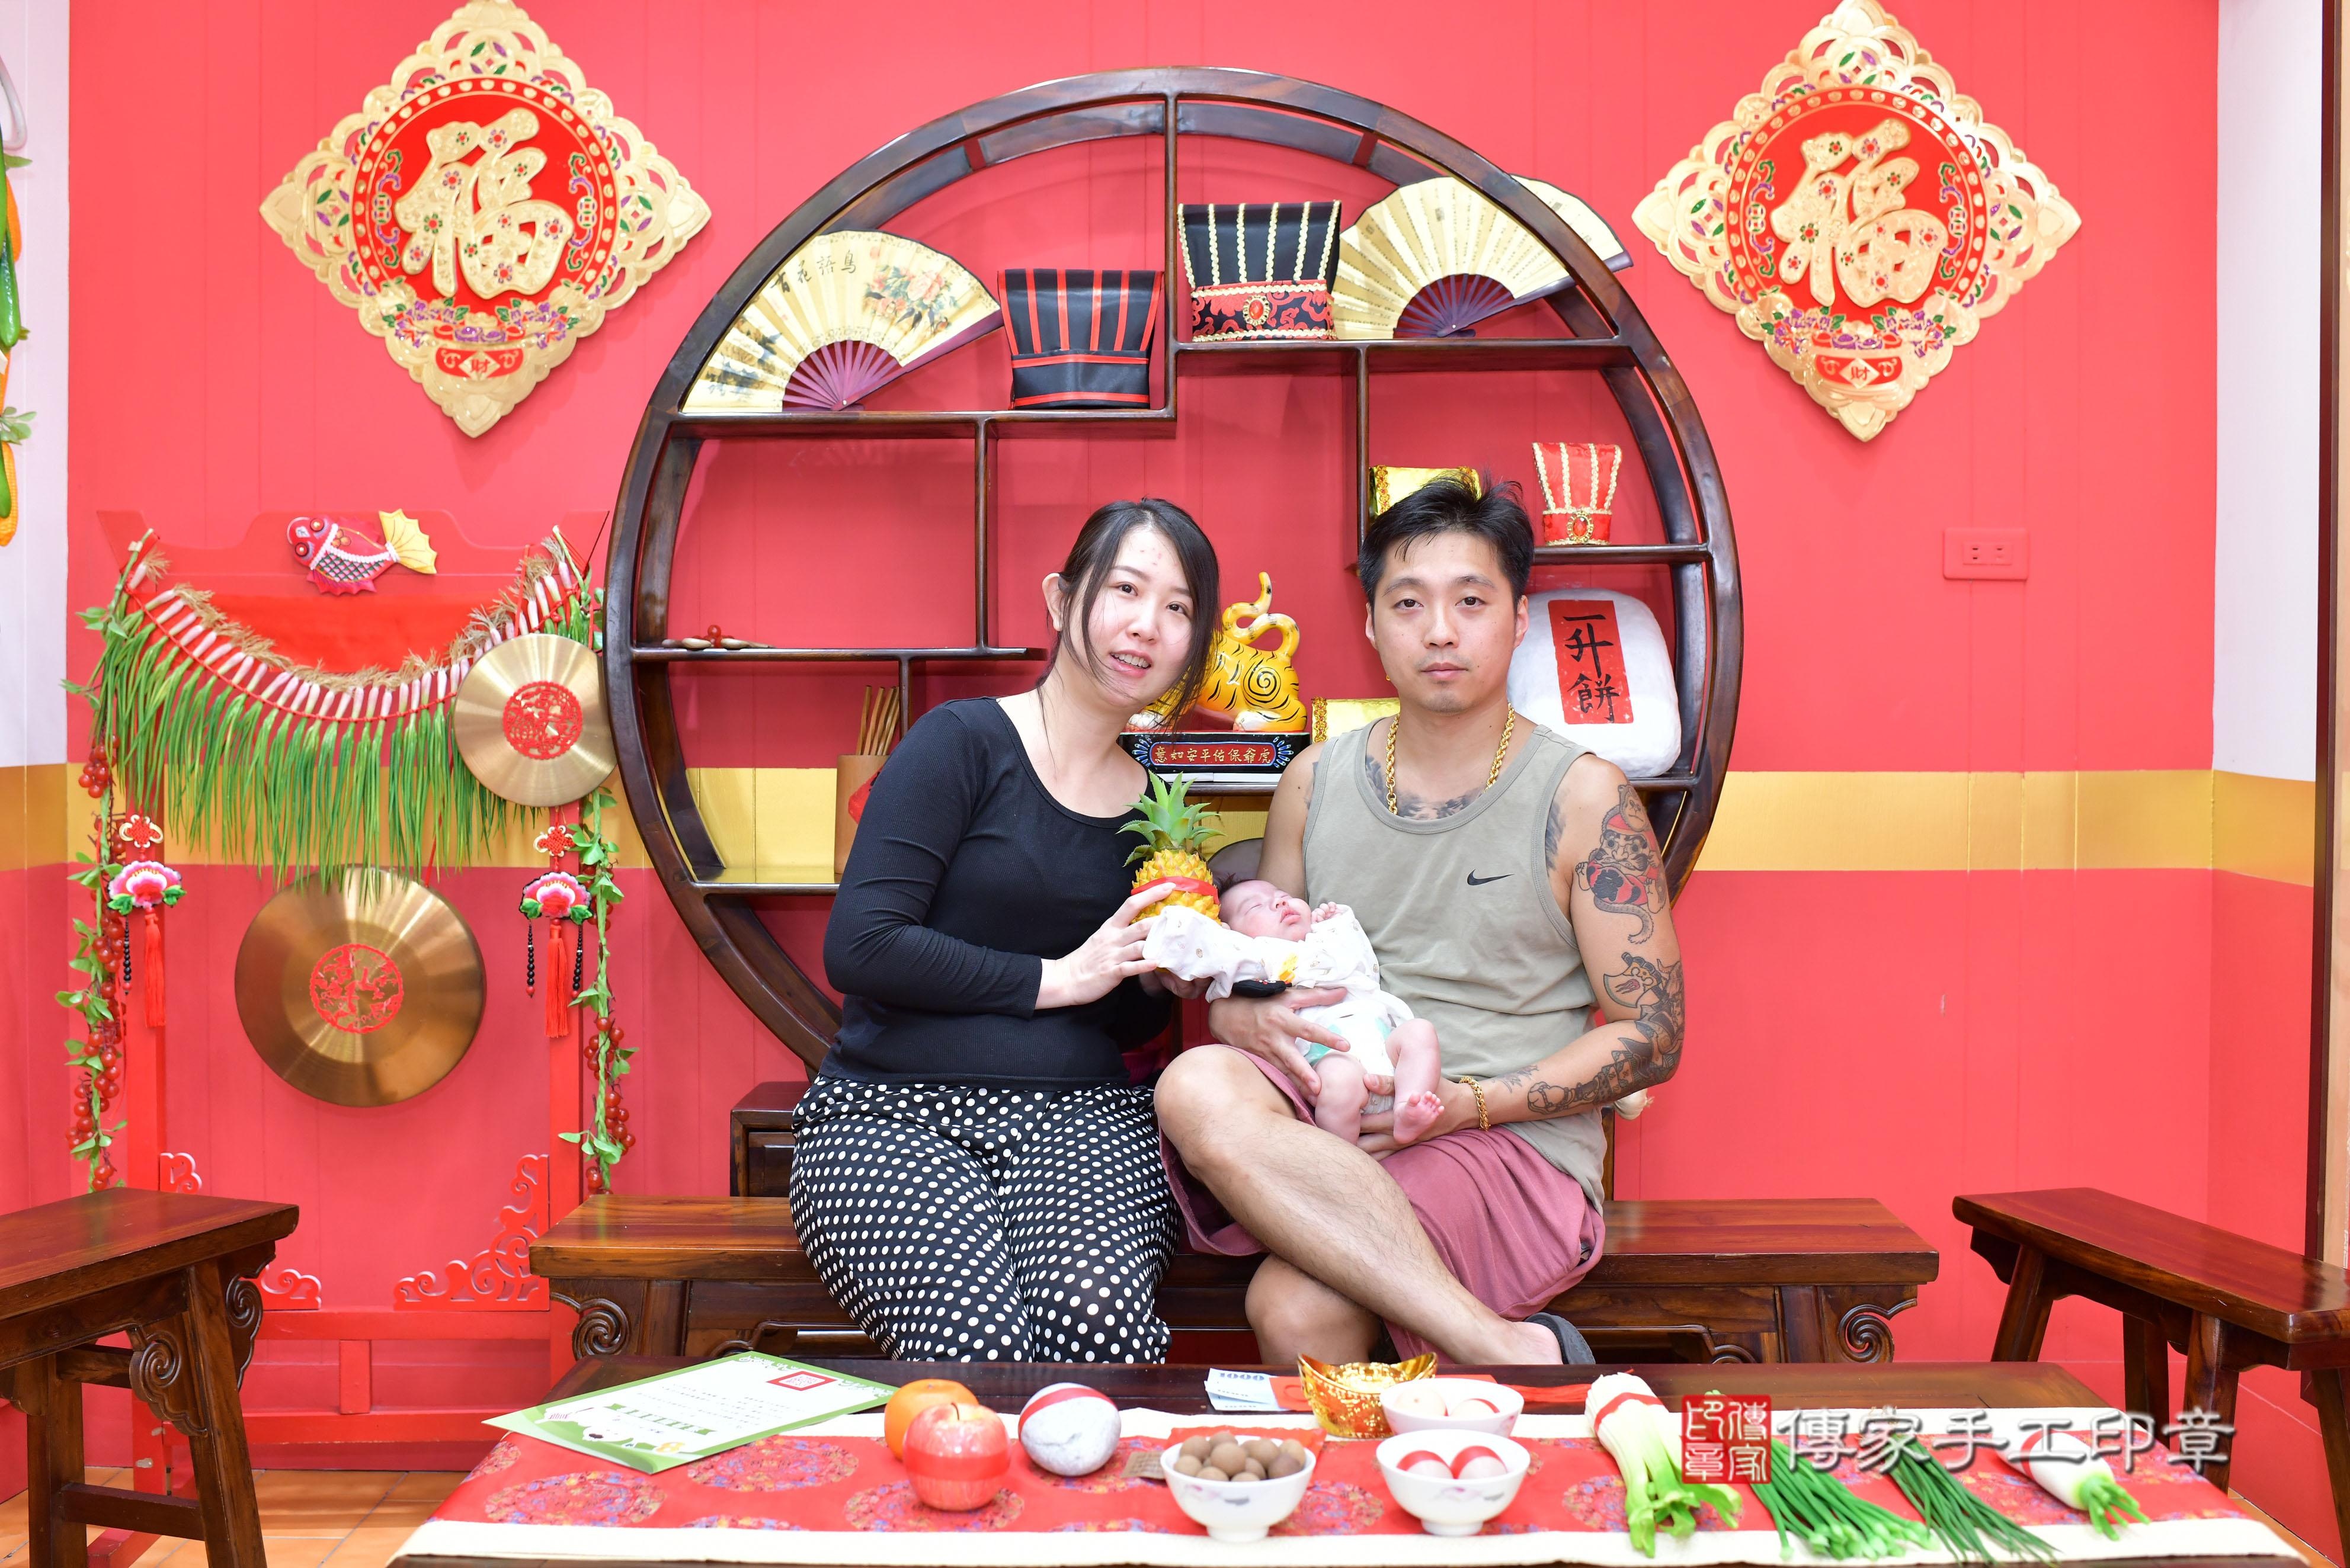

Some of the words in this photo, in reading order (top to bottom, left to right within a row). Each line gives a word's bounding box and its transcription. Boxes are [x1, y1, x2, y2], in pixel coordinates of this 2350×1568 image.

[394, 107, 574, 299] 福
[1770, 118, 1949, 308] 福
[1563, 614, 1619, 723] 一升餅
[1219, 1372, 1265, 1381] 1000
